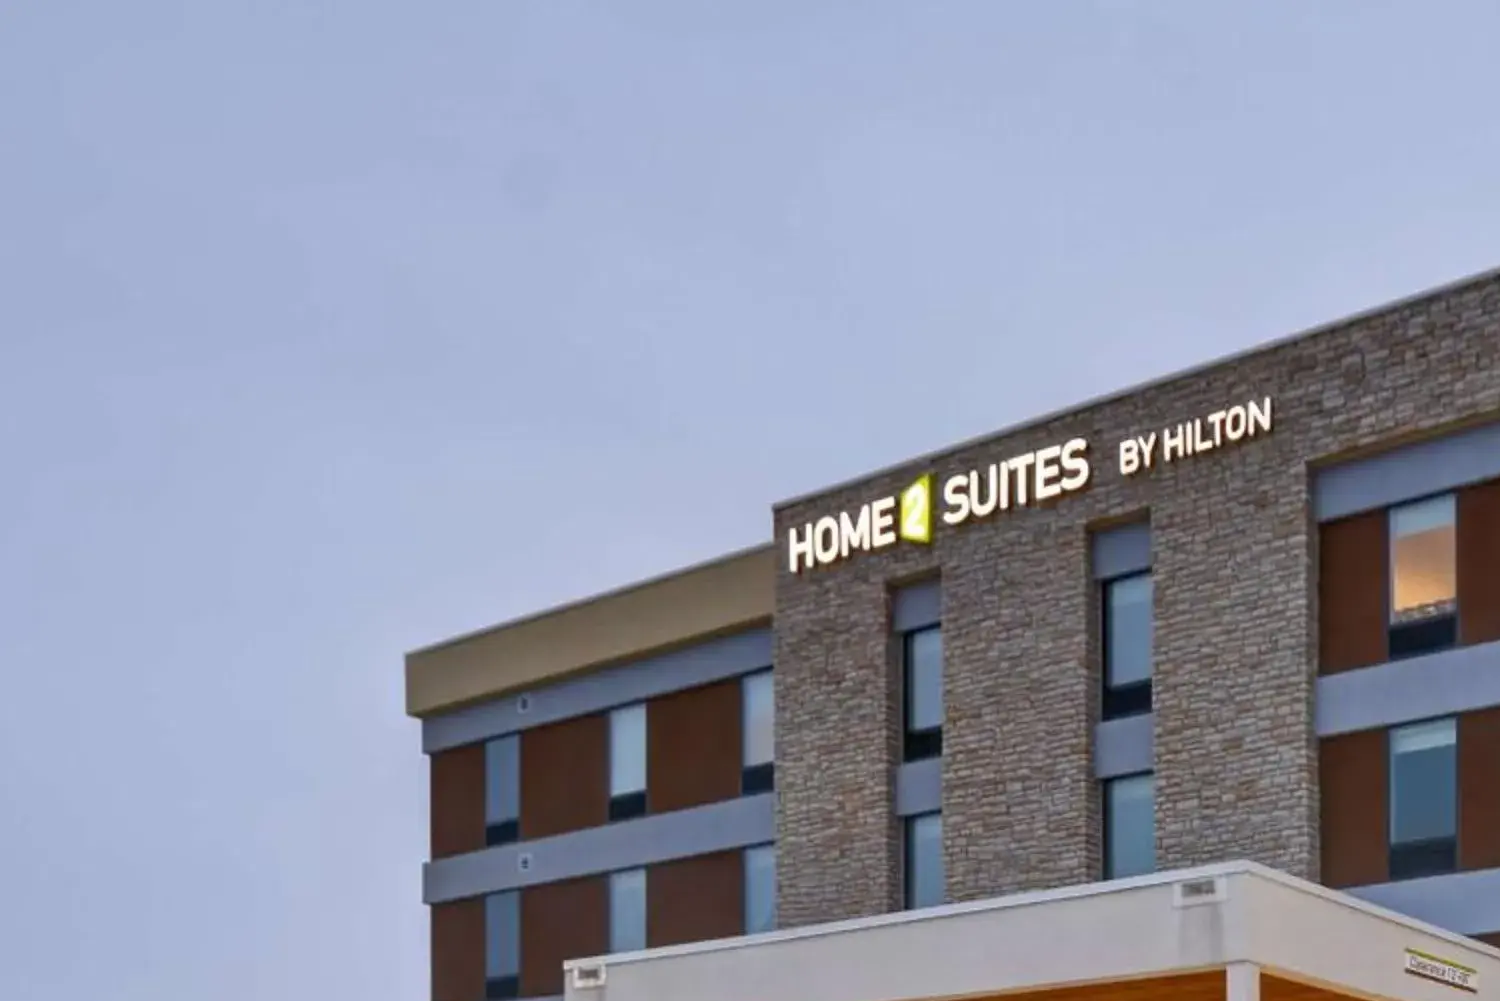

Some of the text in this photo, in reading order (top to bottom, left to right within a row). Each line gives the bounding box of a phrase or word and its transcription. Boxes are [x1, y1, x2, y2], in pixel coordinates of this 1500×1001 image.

[789, 396, 1272, 573] HOME 2 SUITES BY HILTON
